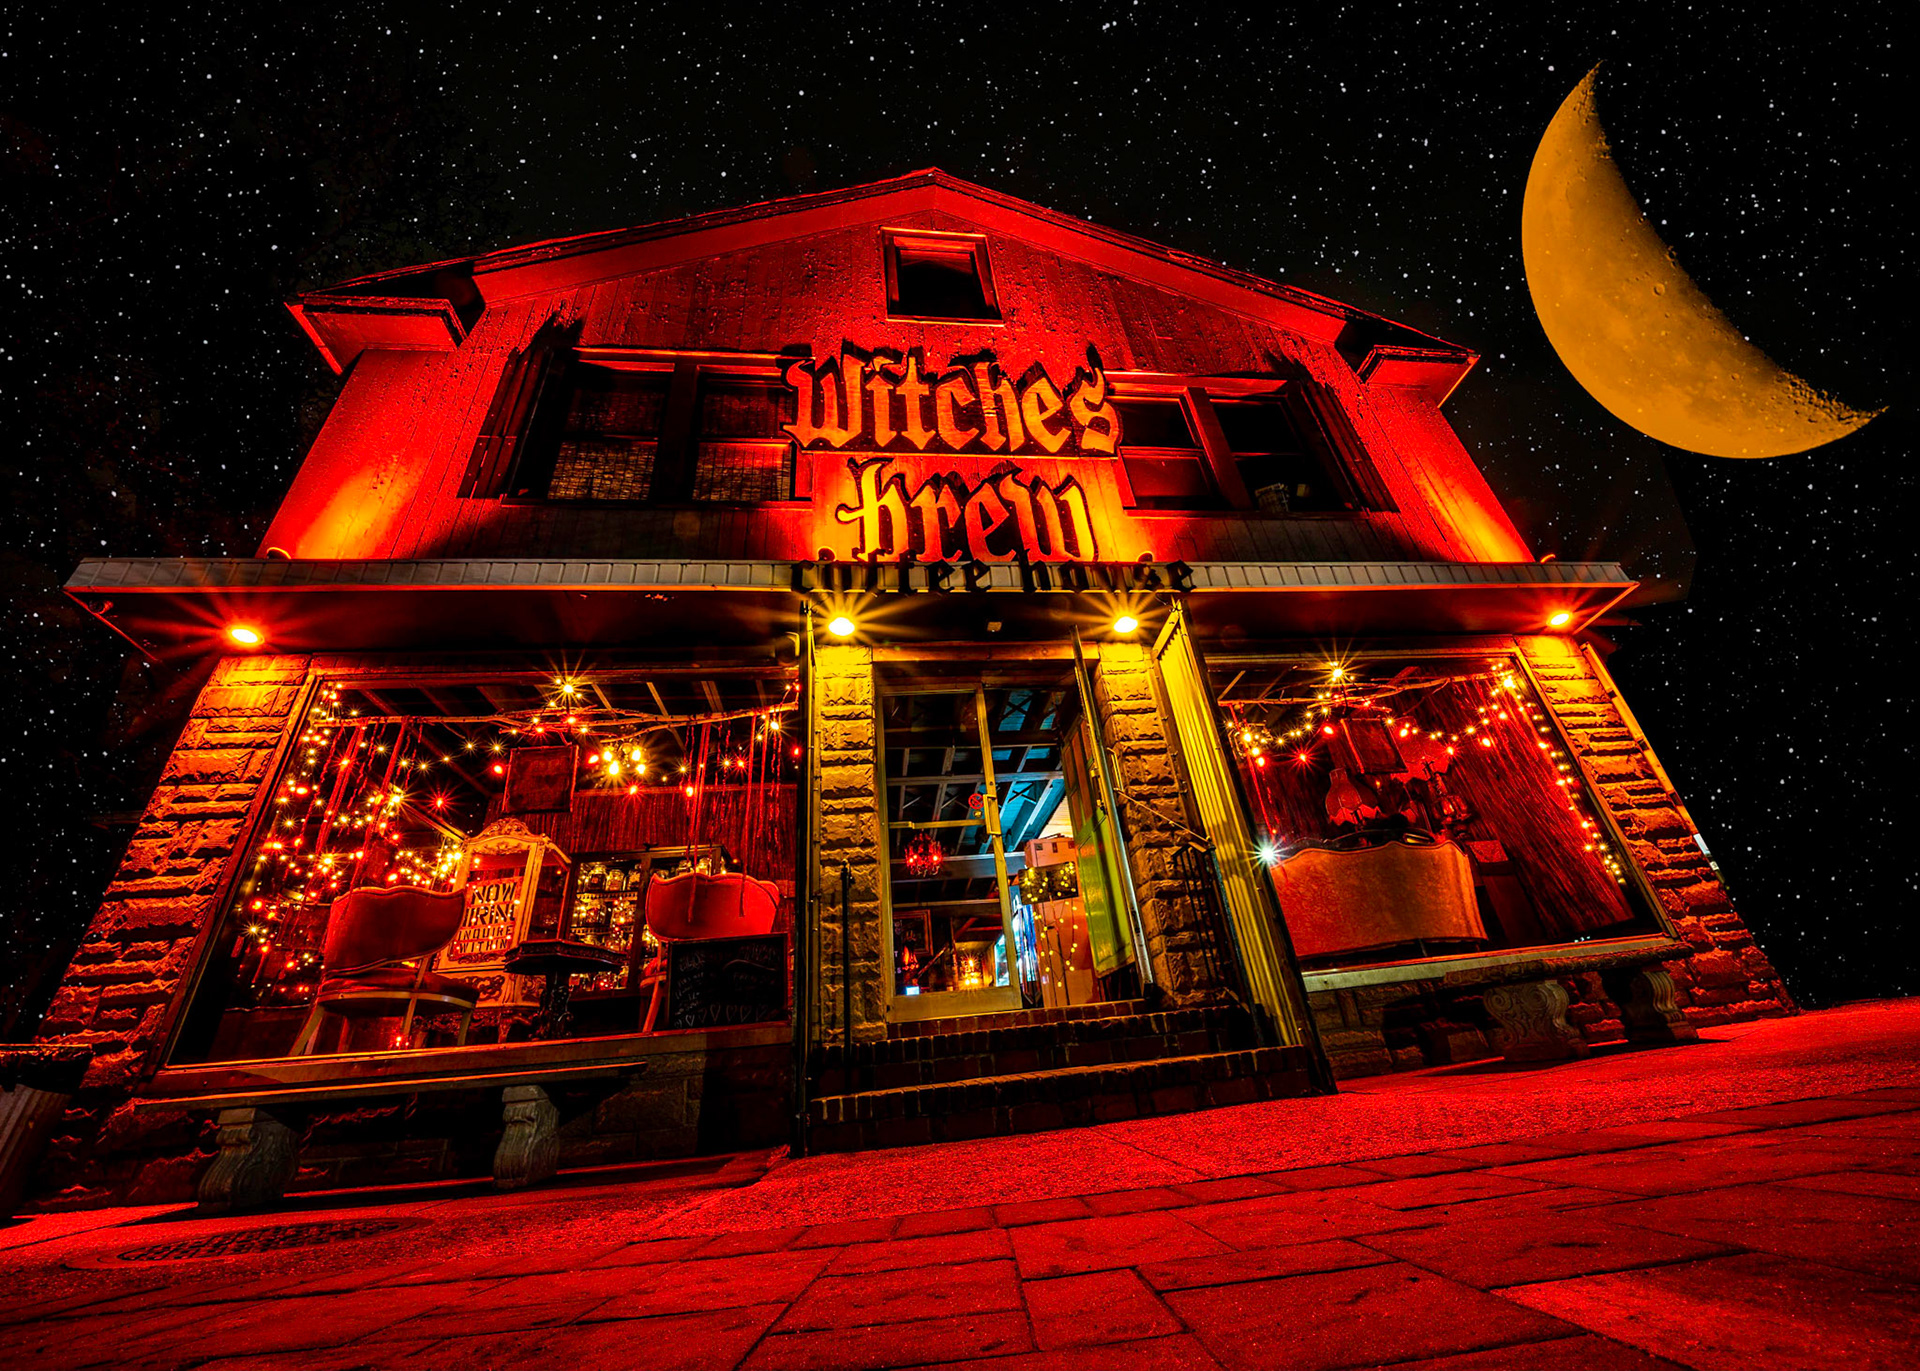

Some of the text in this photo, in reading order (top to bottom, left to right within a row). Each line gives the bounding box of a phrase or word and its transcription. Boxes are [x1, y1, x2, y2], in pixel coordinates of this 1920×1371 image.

[790, 547, 1197, 593] coffee house
[471, 882, 517, 904] NOW
[458, 926, 513, 941] INQUIRE
[459, 938, 508, 953] WITHIN
